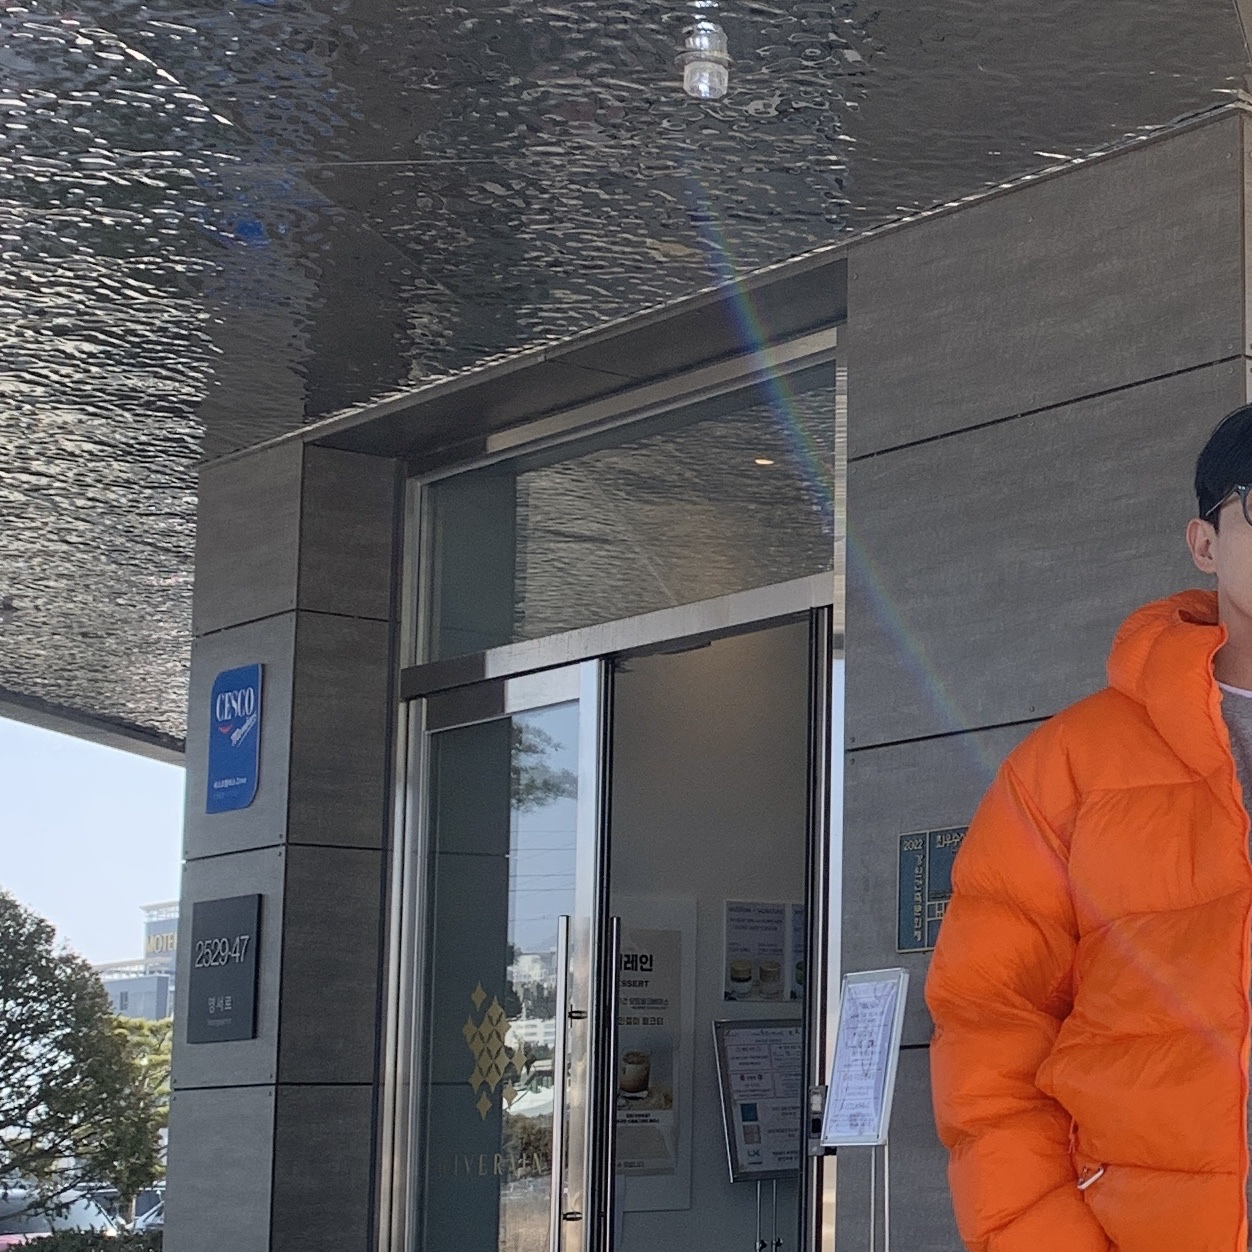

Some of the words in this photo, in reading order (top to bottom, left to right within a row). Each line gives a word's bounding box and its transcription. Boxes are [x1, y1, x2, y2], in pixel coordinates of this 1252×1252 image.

[216, 687, 254, 721] CESCO
[903, 839, 923, 851] 2022
[194, 935, 250, 968] 2529-47
[619, 953, 654, 972] 레인
[620, 980, 650, 988] SSERT
